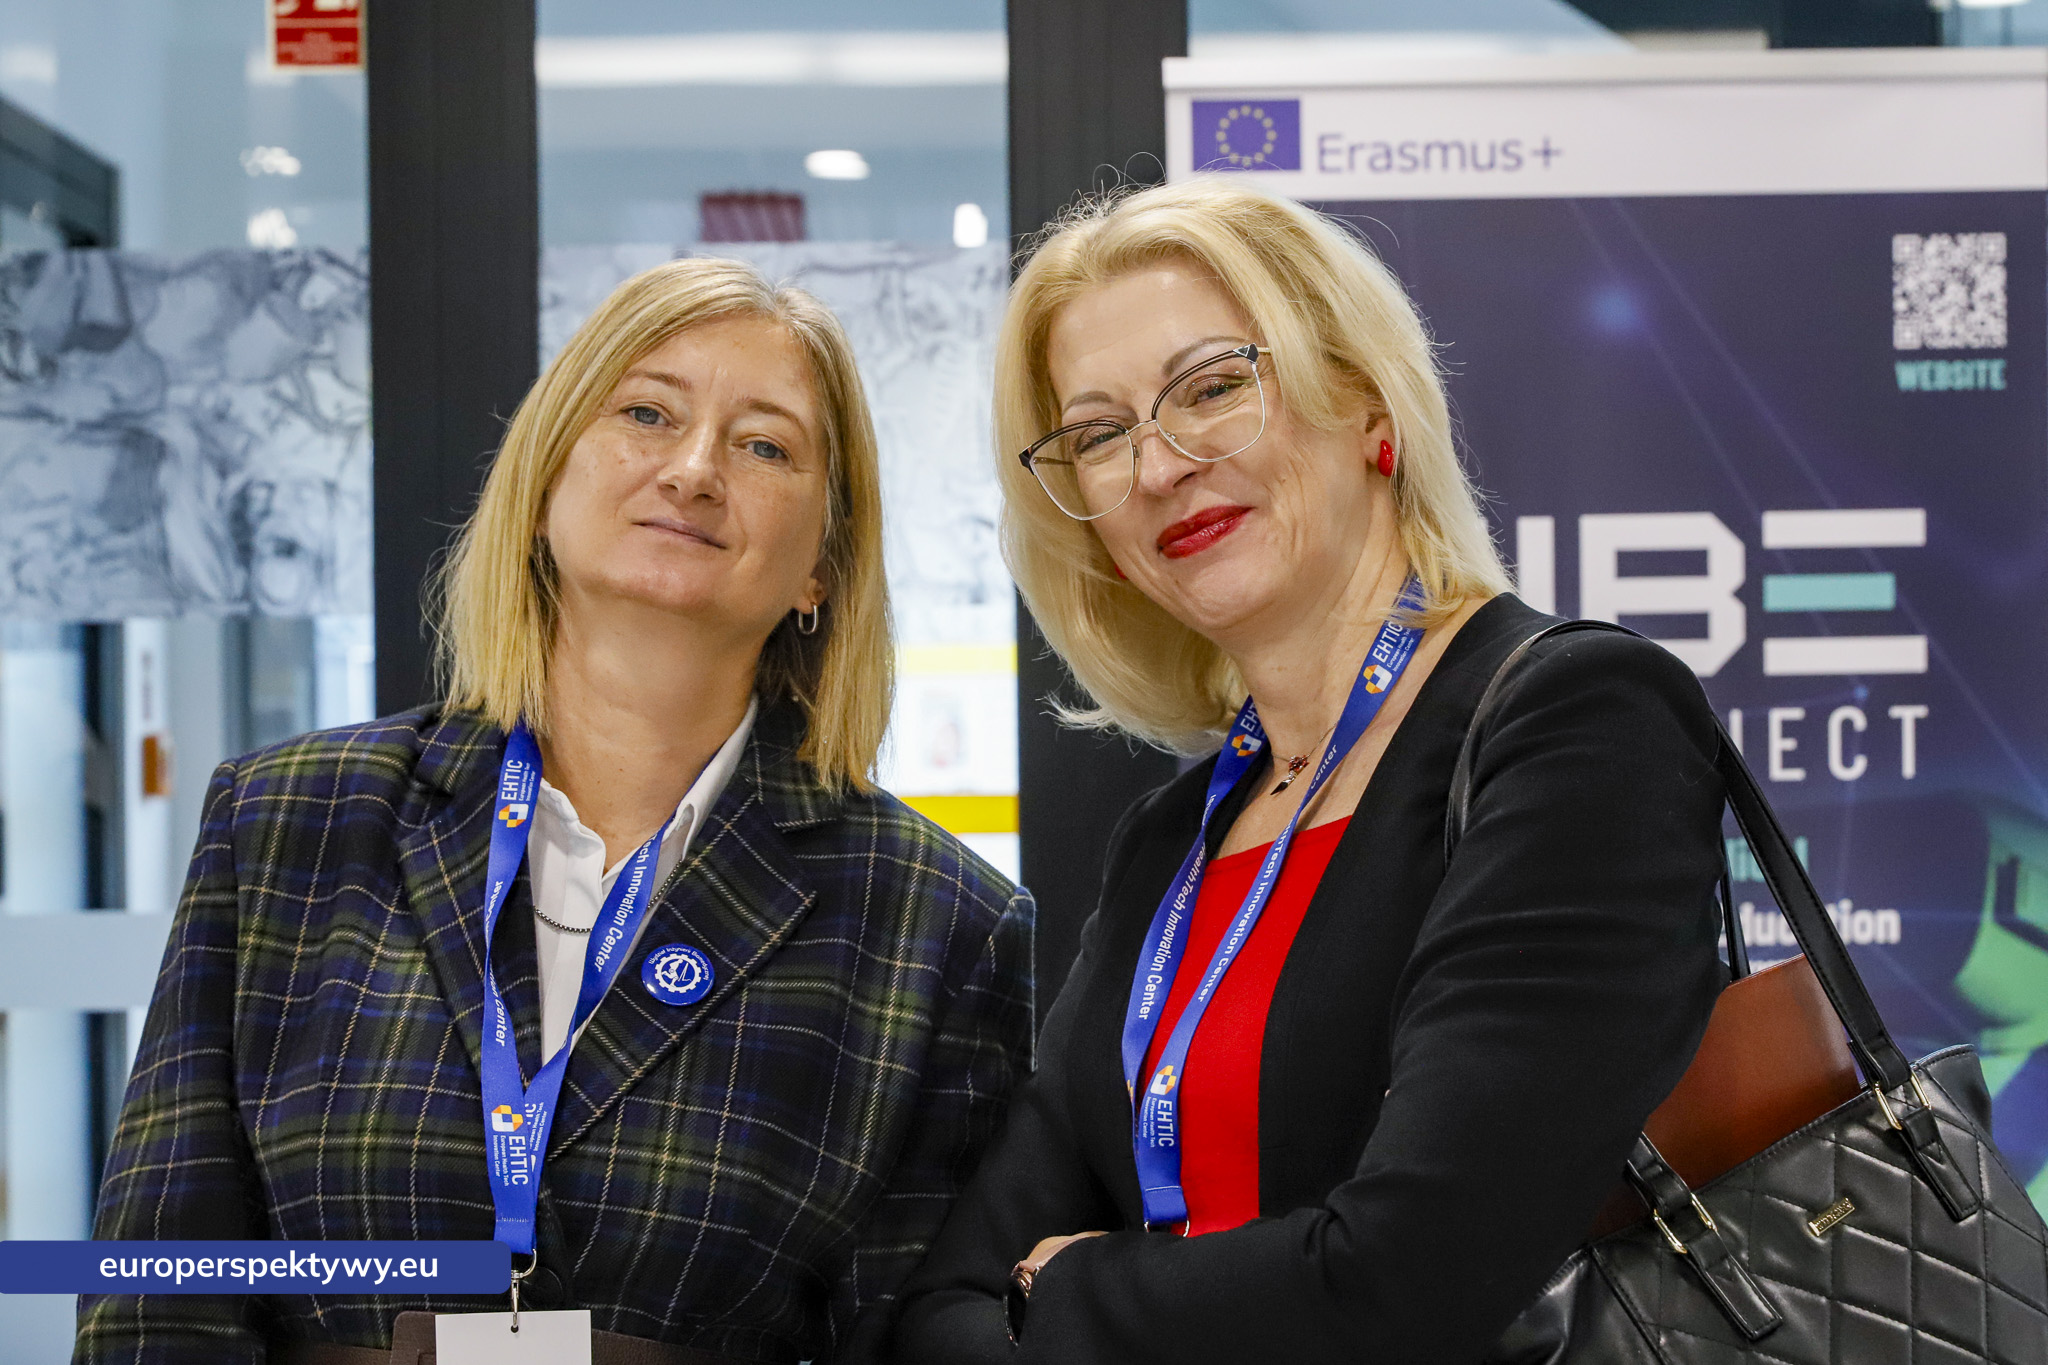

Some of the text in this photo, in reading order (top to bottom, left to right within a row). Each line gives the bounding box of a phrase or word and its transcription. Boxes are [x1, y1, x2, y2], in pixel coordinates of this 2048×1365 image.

[1316, 132, 1562, 174] Erasmus+
[1894, 358, 2007, 391] WEBSITE
[1371, 619, 1404, 664] EHTIC
[500, 759, 523, 802] EHTIC
[613, 866, 648, 926] Innovation
[1225, 881, 1269, 955] Innovation
[594, 926, 624, 973] Center
[1150, 910, 1183, 972] Innovation
[1138, 974, 1163, 1021] Center
[1197, 957, 1229, 1003] Center
[495, 998, 508, 1047] Center
[1157, 1099, 1175, 1147] EHTIC
[508, 1135, 529, 1186] EHTIC
